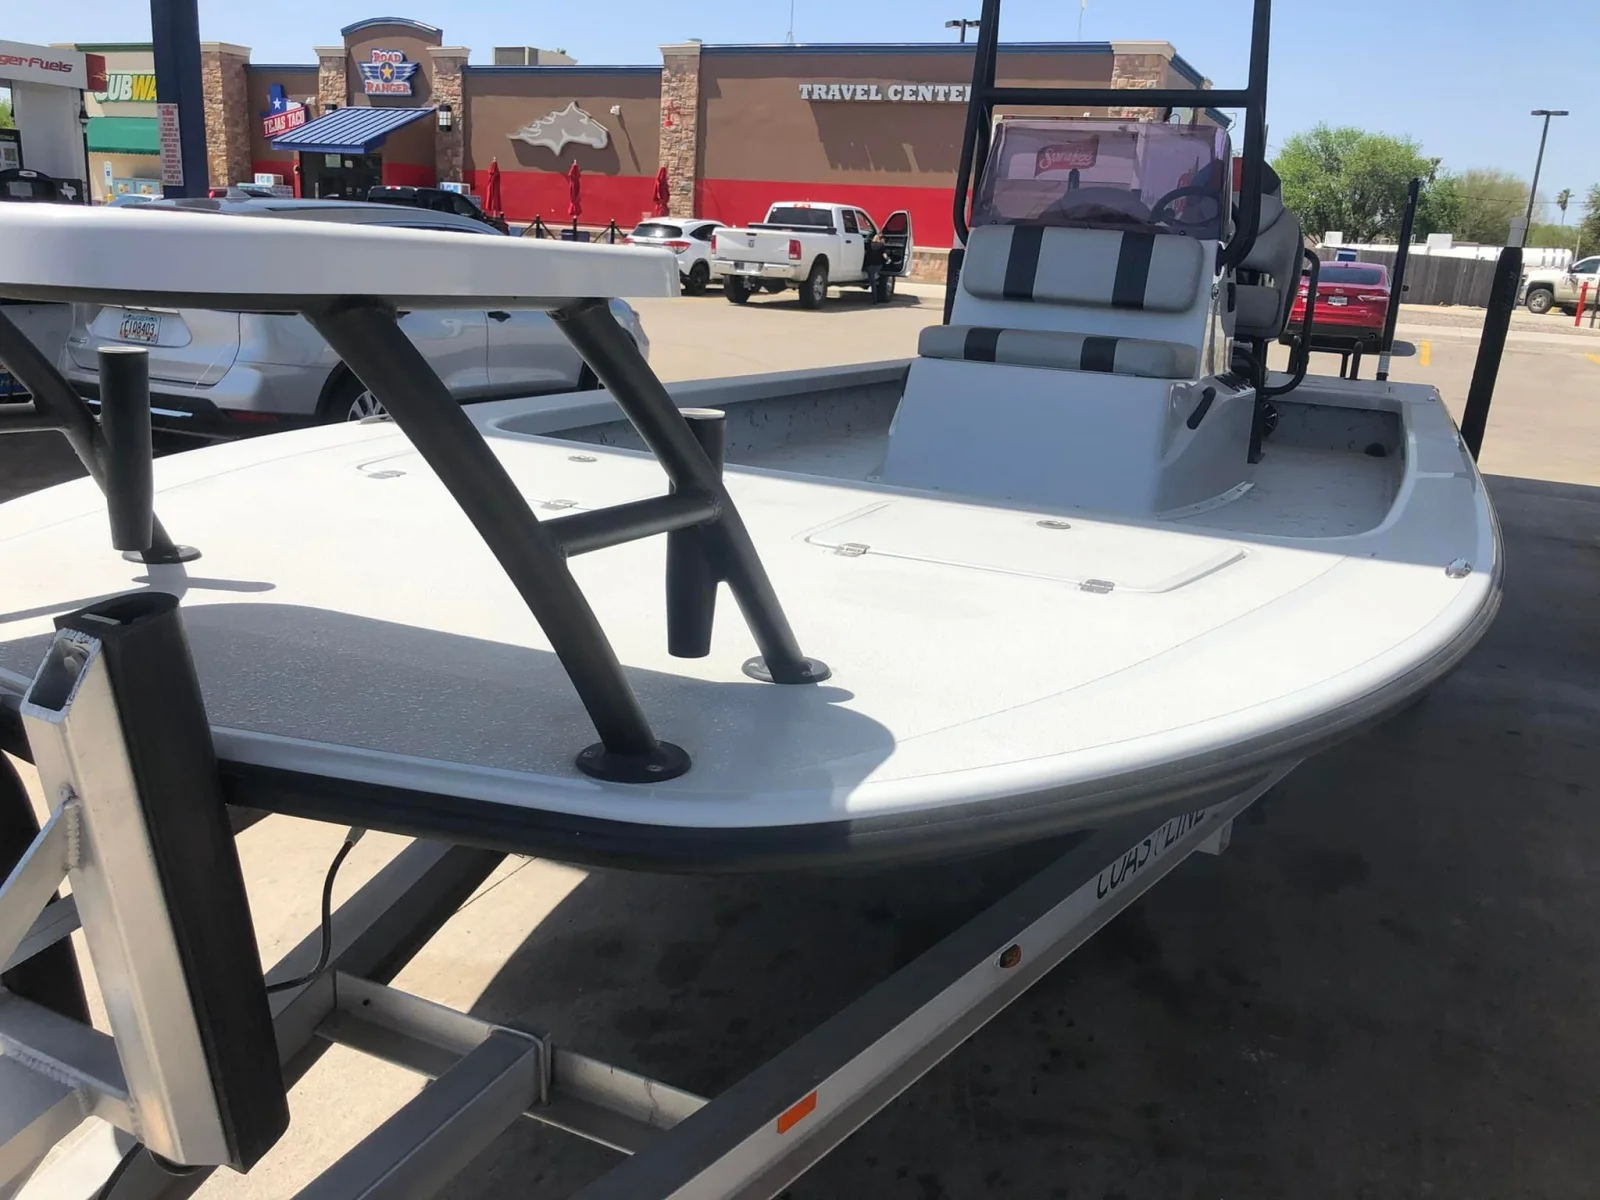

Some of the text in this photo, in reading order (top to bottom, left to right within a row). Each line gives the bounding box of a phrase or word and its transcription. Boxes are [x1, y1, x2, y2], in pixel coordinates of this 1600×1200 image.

[372, 50, 402, 63] ROAD
[365, 81, 410, 94] RANGER
[799, 84, 881, 101] TRAVEL
[287, 109, 305, 128] TACO
